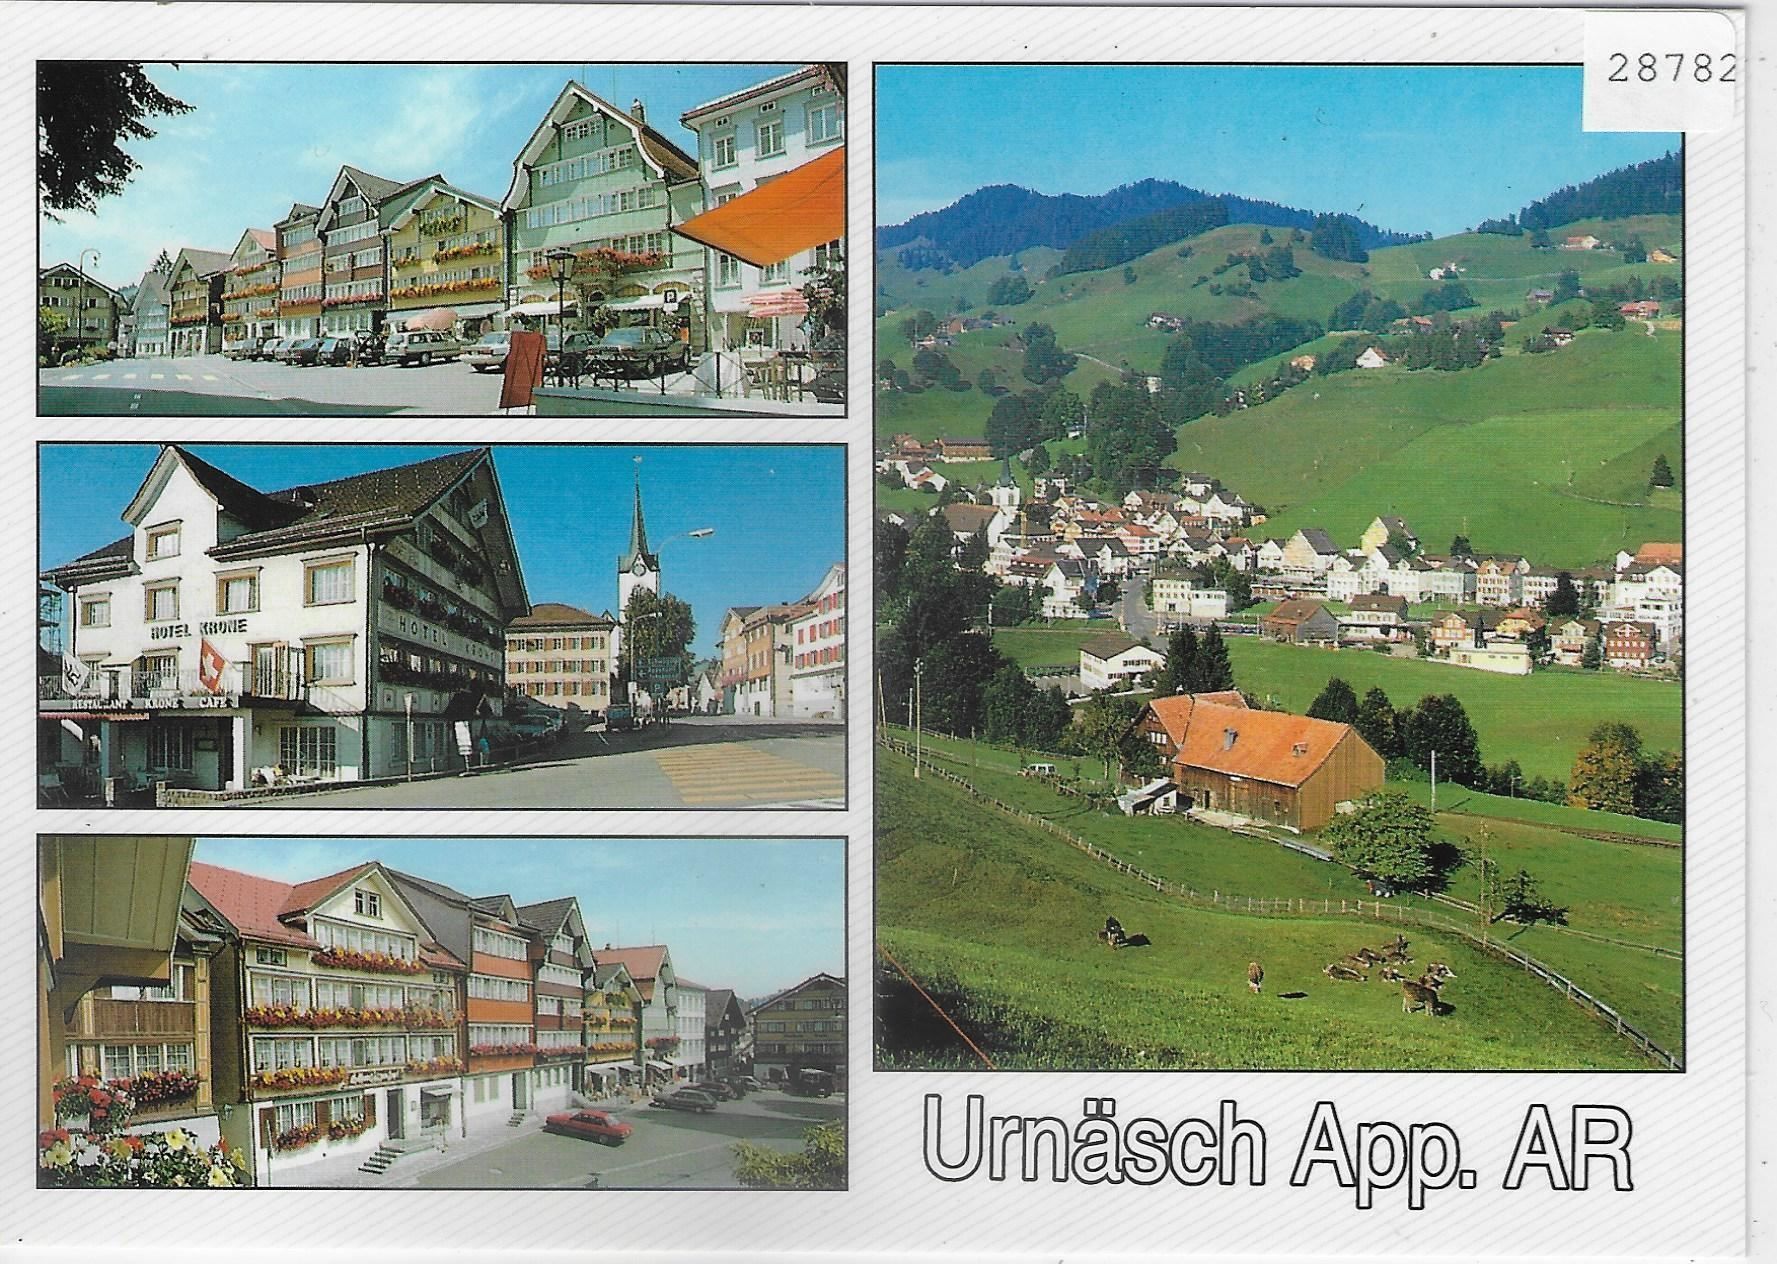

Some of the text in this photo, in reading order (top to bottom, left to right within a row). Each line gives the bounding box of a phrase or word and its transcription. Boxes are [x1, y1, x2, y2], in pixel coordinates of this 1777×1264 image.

[1608, 52, 1737, 83] 28782
[151, 619, 248, 640] HOTEL KRONE
[400, 616, 448, 646] HOTEL
[144, 697, 180, 710] KRONE
[923, 1092, 1635, 1211] Urnäsch App. AR
